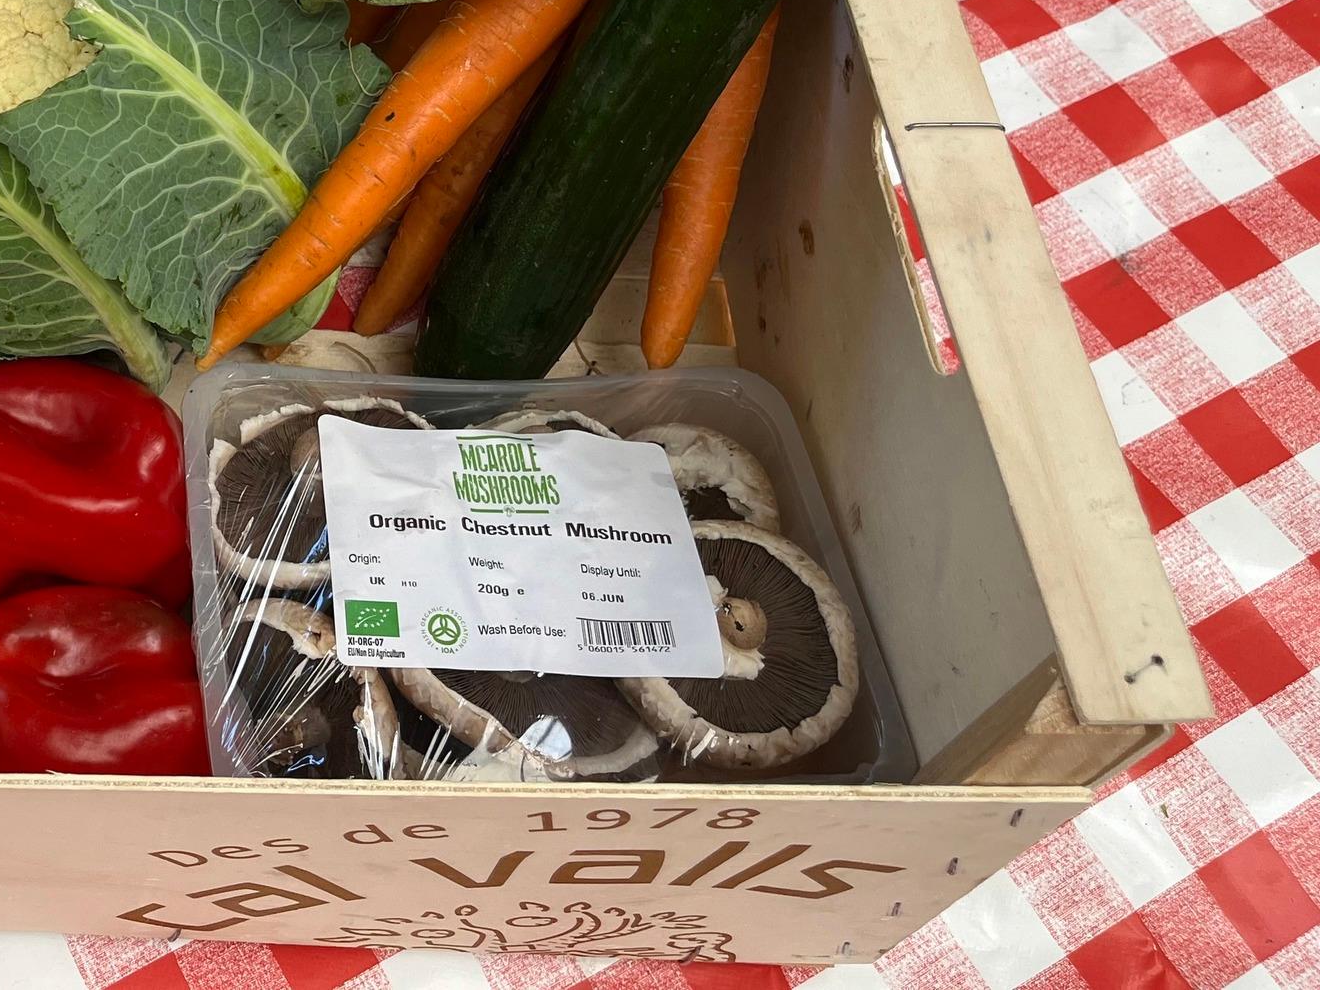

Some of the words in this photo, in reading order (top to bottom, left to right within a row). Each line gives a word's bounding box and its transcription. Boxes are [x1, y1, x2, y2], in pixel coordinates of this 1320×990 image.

[458, 443, 541, 473] MCARDLE
[452, 471, 560, 506] MUSHROOMS
[369, 513, 447, 533] Organic
[461, 516, 552, 537] Chestnut
[565, 522, 672, 545] Mushroom
[348, 553, 381, 565] Origin:
[468, 556, 505, 570] Weight:
[580, 563, 614, 579] Display
[616, 566, 641, 578] Until:
[369, 576, 386, 586] UK
[477, 583, 510, 597] 200g
[477, 624, 507, 636] Wash
[509, 624, 542, 636] Before
[544, 625, 567, 638] Use:
[347, 636, 384, 646] XI-ORG-07
[367, 648, 375, 657] EU
[375, 648, 406, 660] Agriculture
[588, 645, 625, 653] 060015
[148, 838, 310, 868] Des
[342, 823, 450, 845] de
[527, 807, 761, 833] 1978
